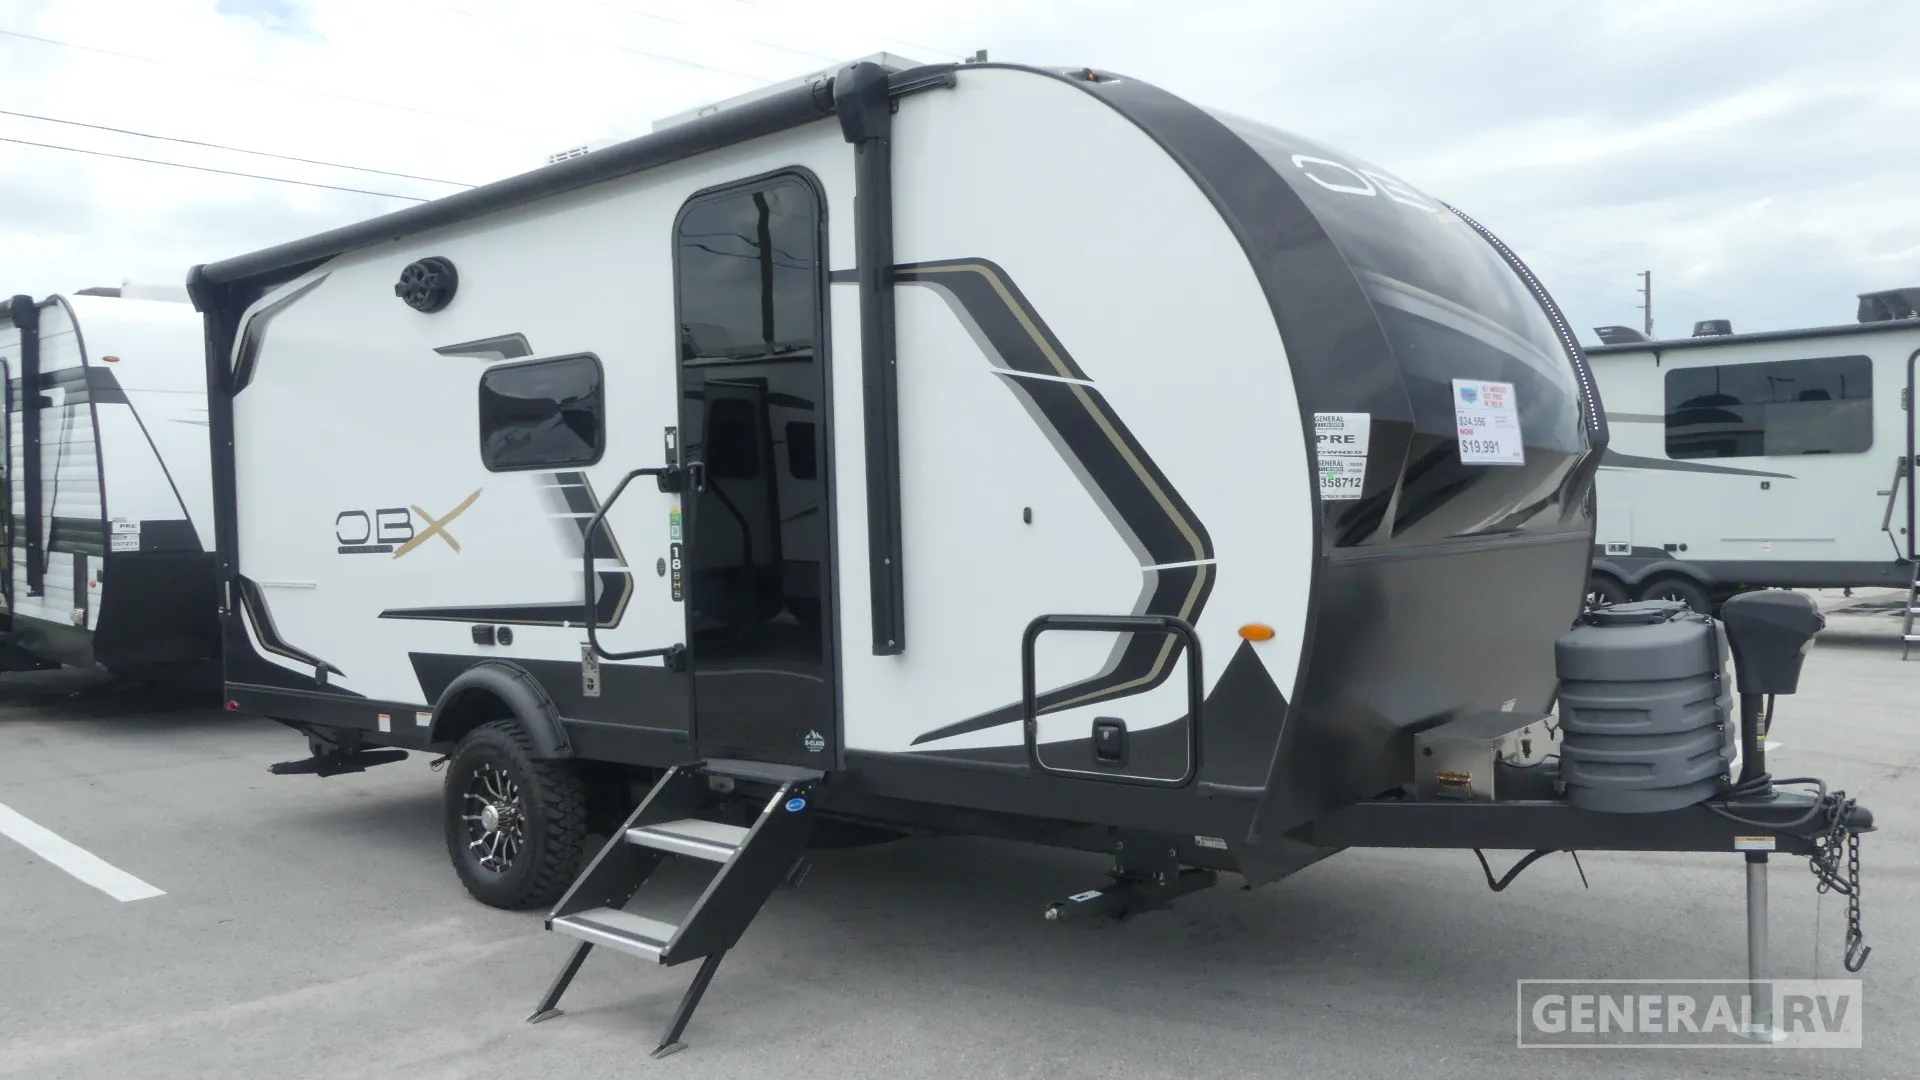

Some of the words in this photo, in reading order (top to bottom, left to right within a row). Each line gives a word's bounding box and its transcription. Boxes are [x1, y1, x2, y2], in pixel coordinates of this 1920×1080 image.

[1316, 434, 1355, 444] PRE
[1461, 439, 1500, 455] $19,991
[1320, 478, 1361, 488] 358712
[335, 486, 483, 560] OBX
